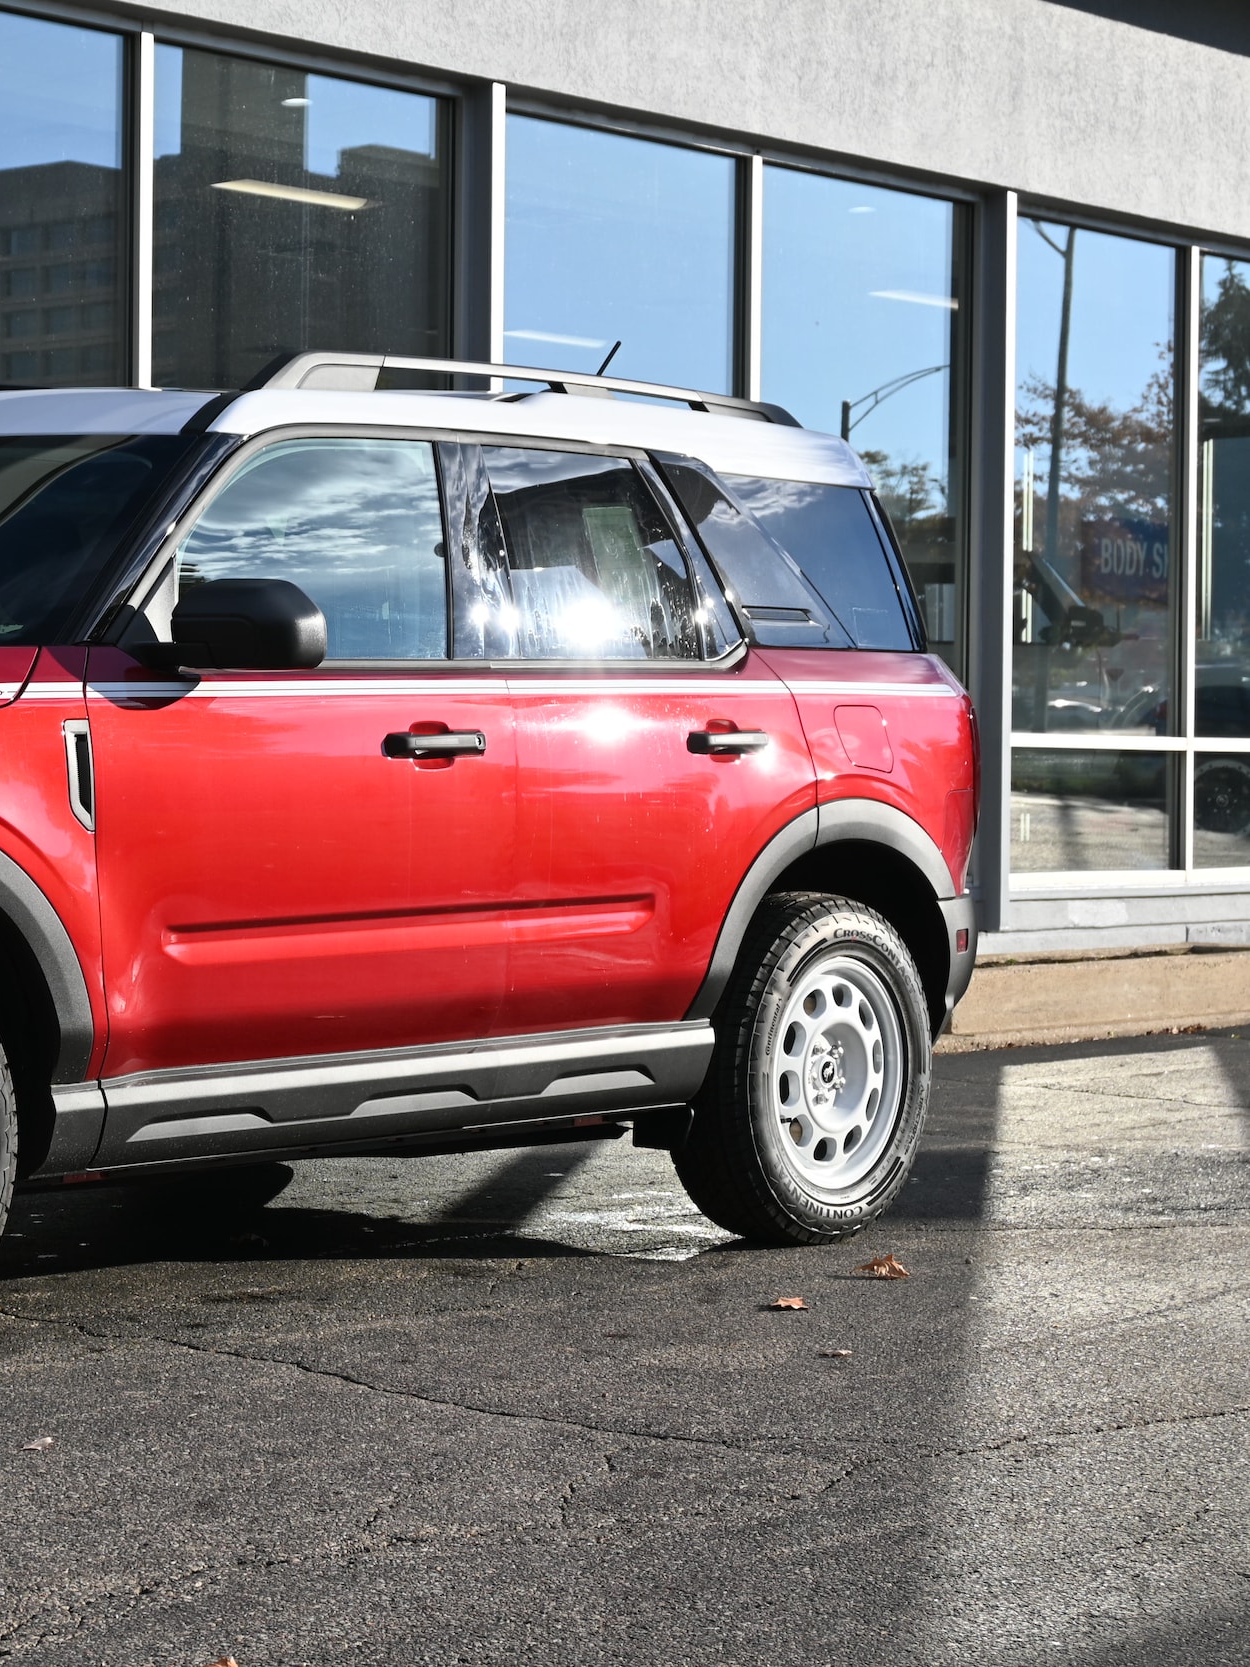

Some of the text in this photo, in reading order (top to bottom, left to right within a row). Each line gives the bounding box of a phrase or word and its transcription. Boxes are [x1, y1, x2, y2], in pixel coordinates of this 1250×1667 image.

[1101, 538, 1148, 576] BODY
[765, 1003, 781, 1056] Continental
[774, 1161, 863, 1219] CONTINENTAL
